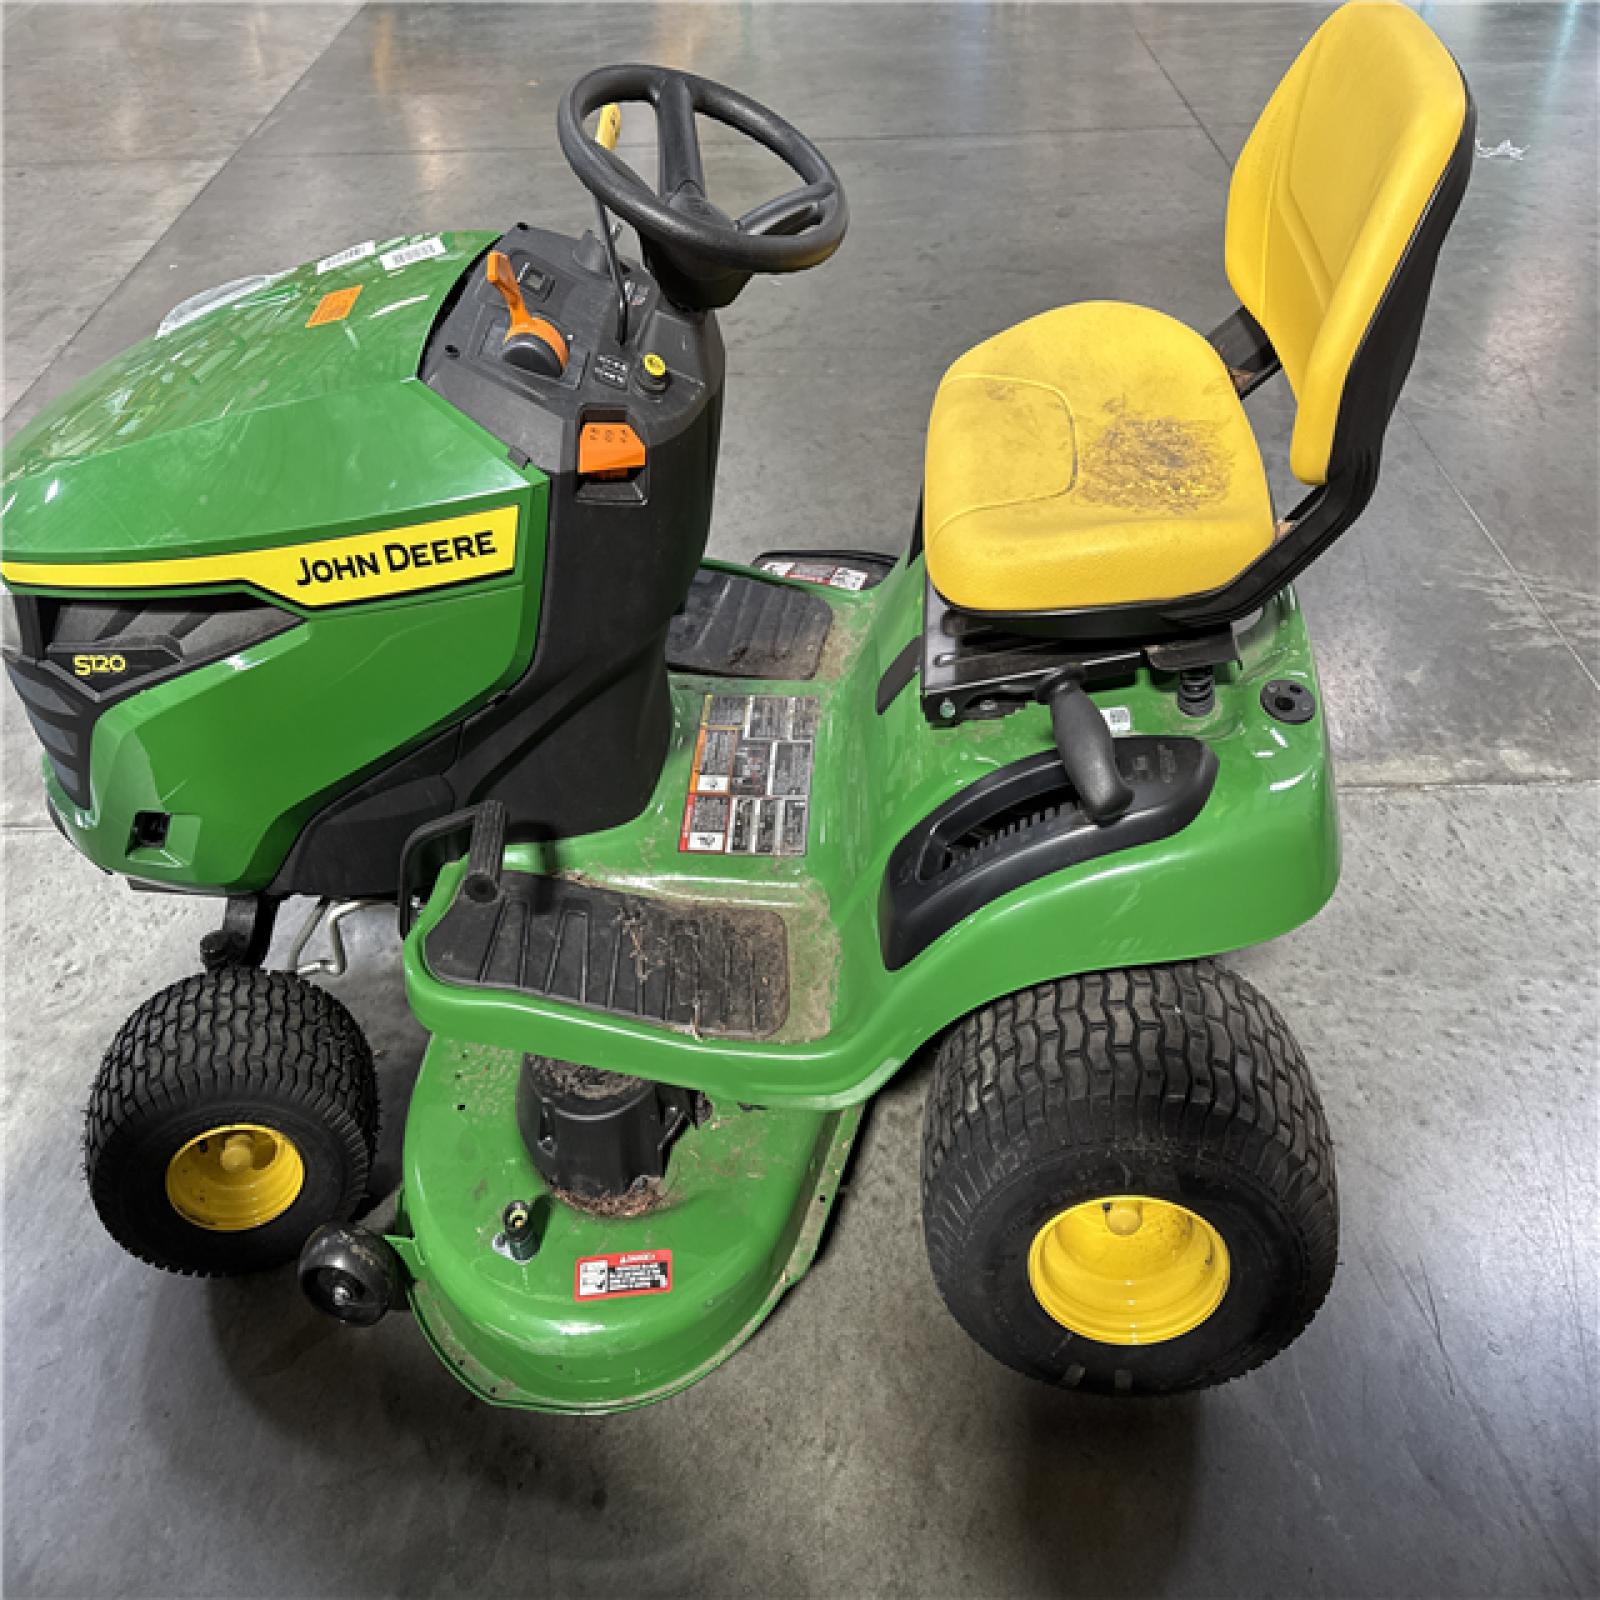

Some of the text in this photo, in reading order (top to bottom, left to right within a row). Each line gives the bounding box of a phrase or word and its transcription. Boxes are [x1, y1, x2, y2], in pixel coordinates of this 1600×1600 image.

[297, 530, 497, 586] JOHN DEERE
[73, 655, 126, 678] S120
